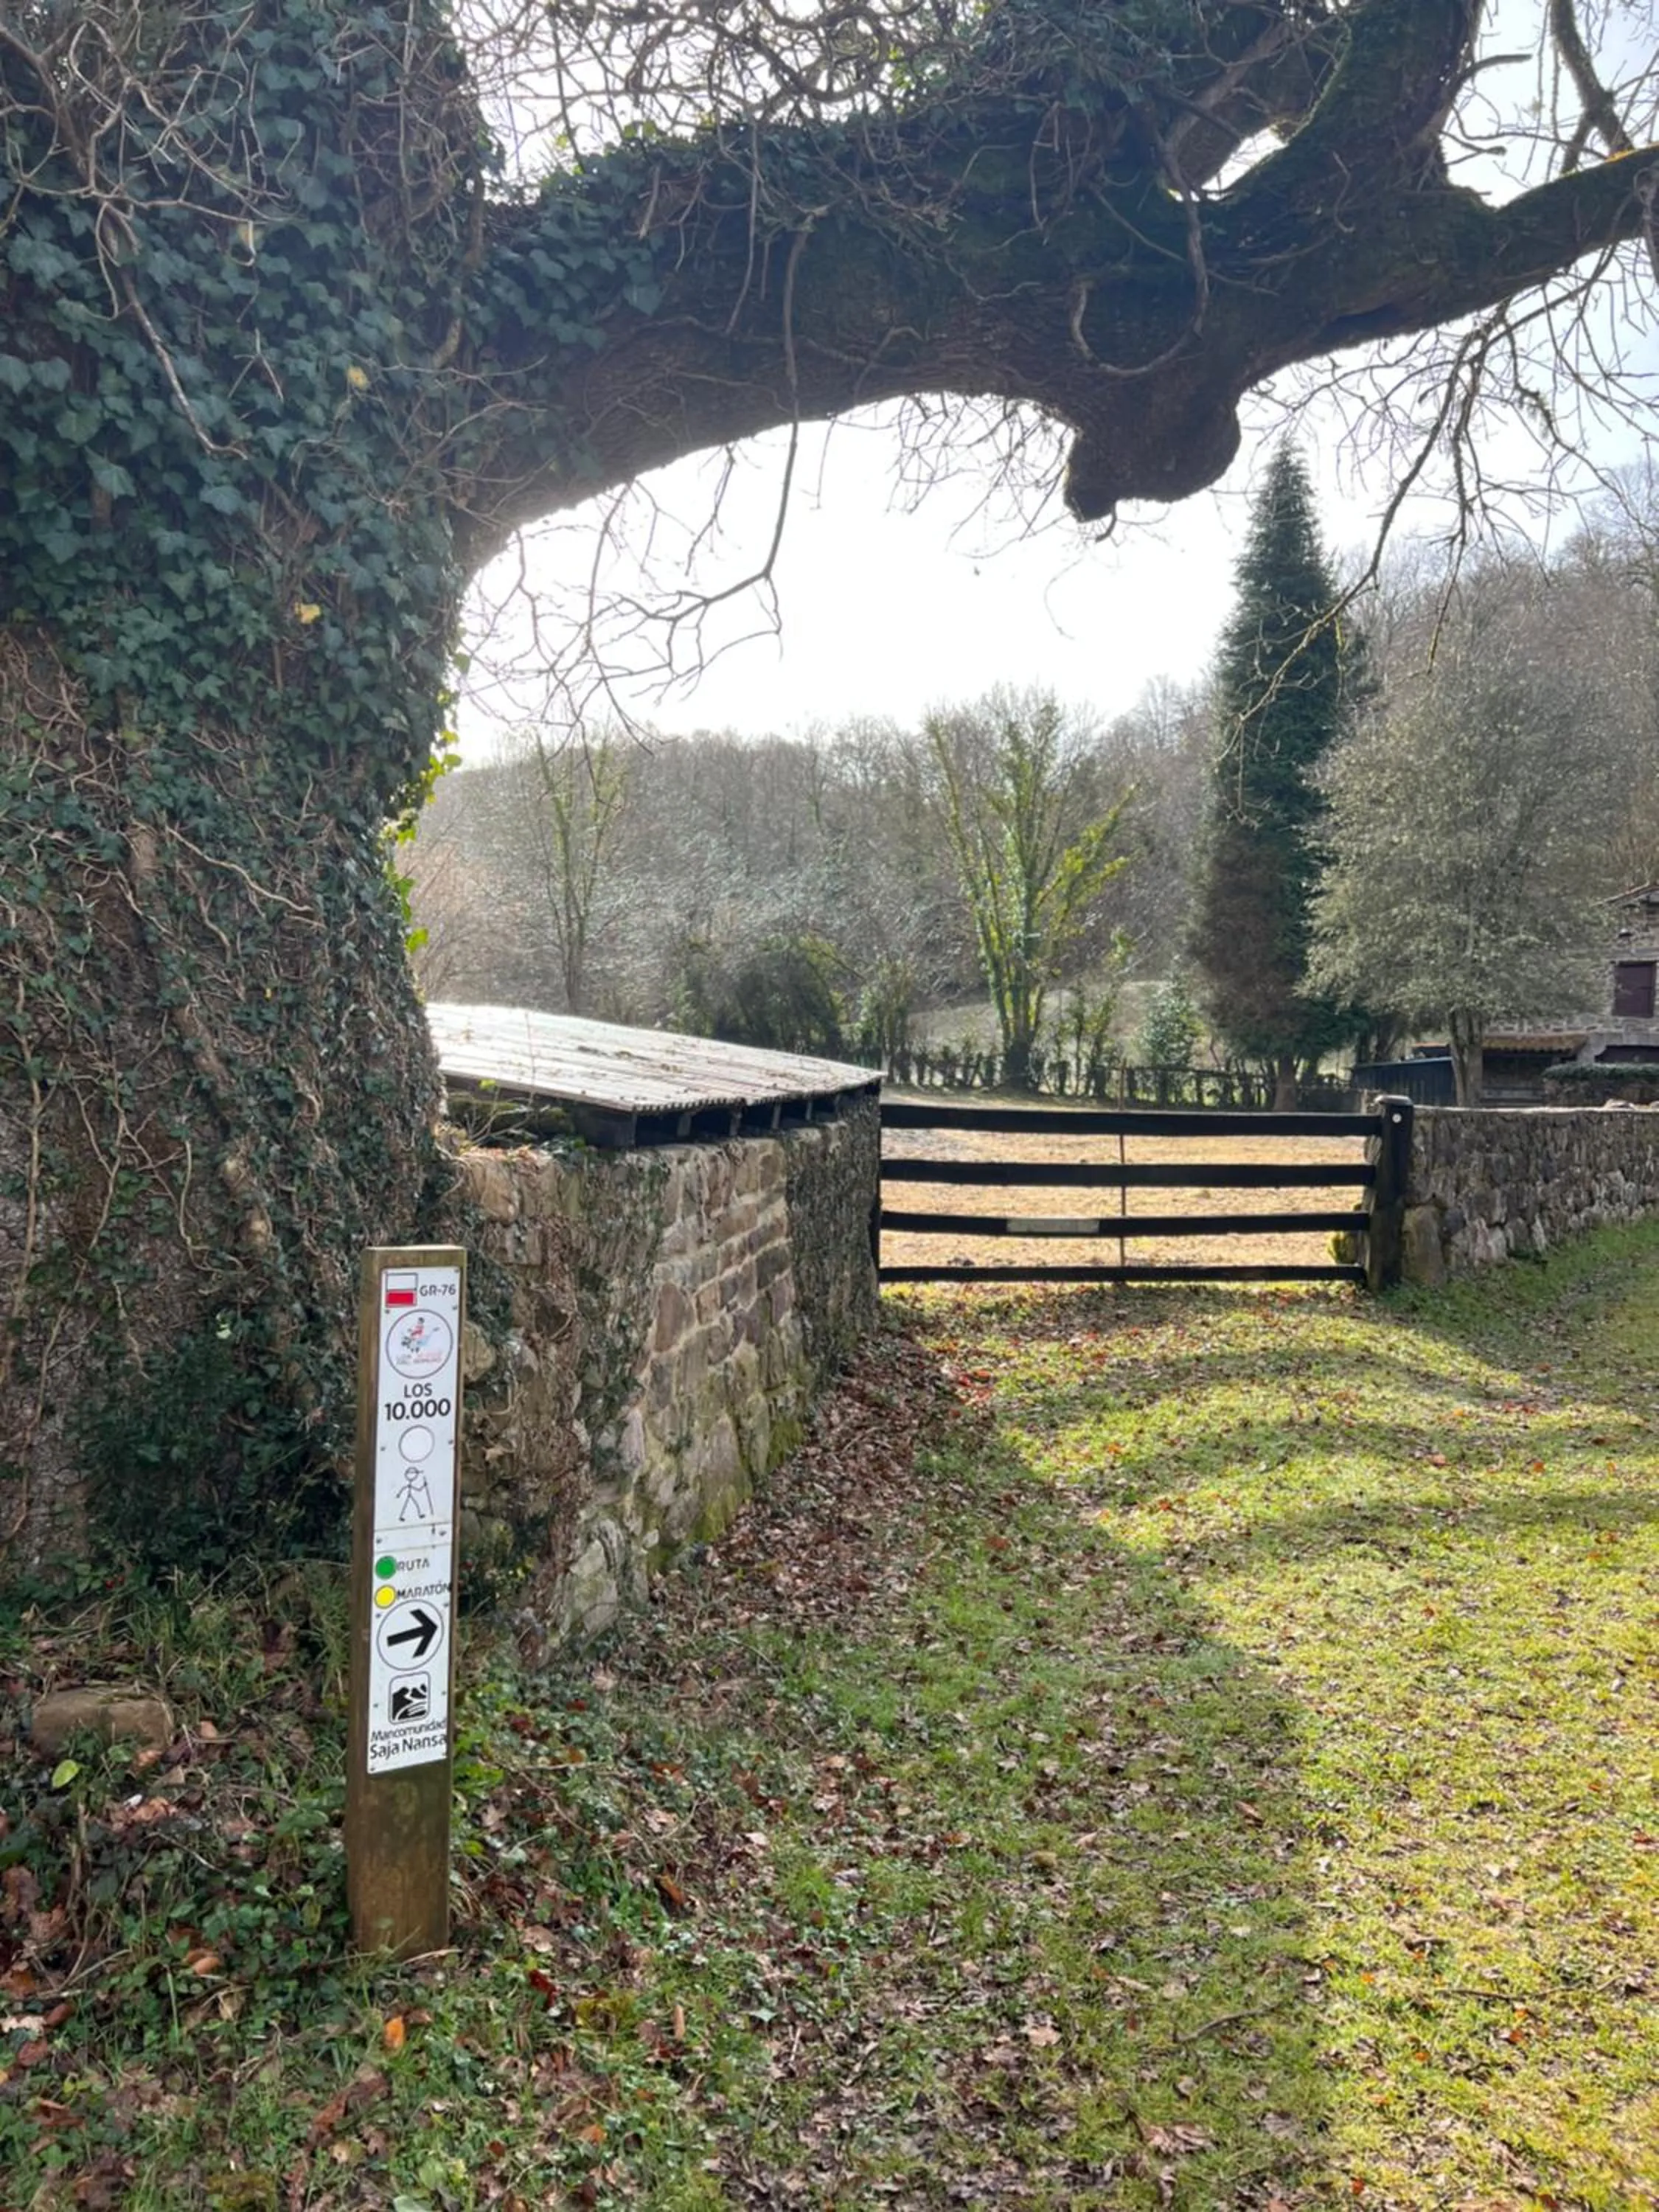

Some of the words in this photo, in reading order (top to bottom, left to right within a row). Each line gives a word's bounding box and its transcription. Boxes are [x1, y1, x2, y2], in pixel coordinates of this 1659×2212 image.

[420, 1284, 456, 1297] GR-76
[404, 1382, 433, 1398] LOS
[385, 1398, 451, 1421] 10.000
[397, 1559, 430, 1571] RUTA
[397, 1580, 451, 1599] MARATÓN
[371, 1718, 447, 1742] Mancomunidad
[369, 1742, 400, 1760] Saja
[403, 1733, 447, 1753] Nansa
